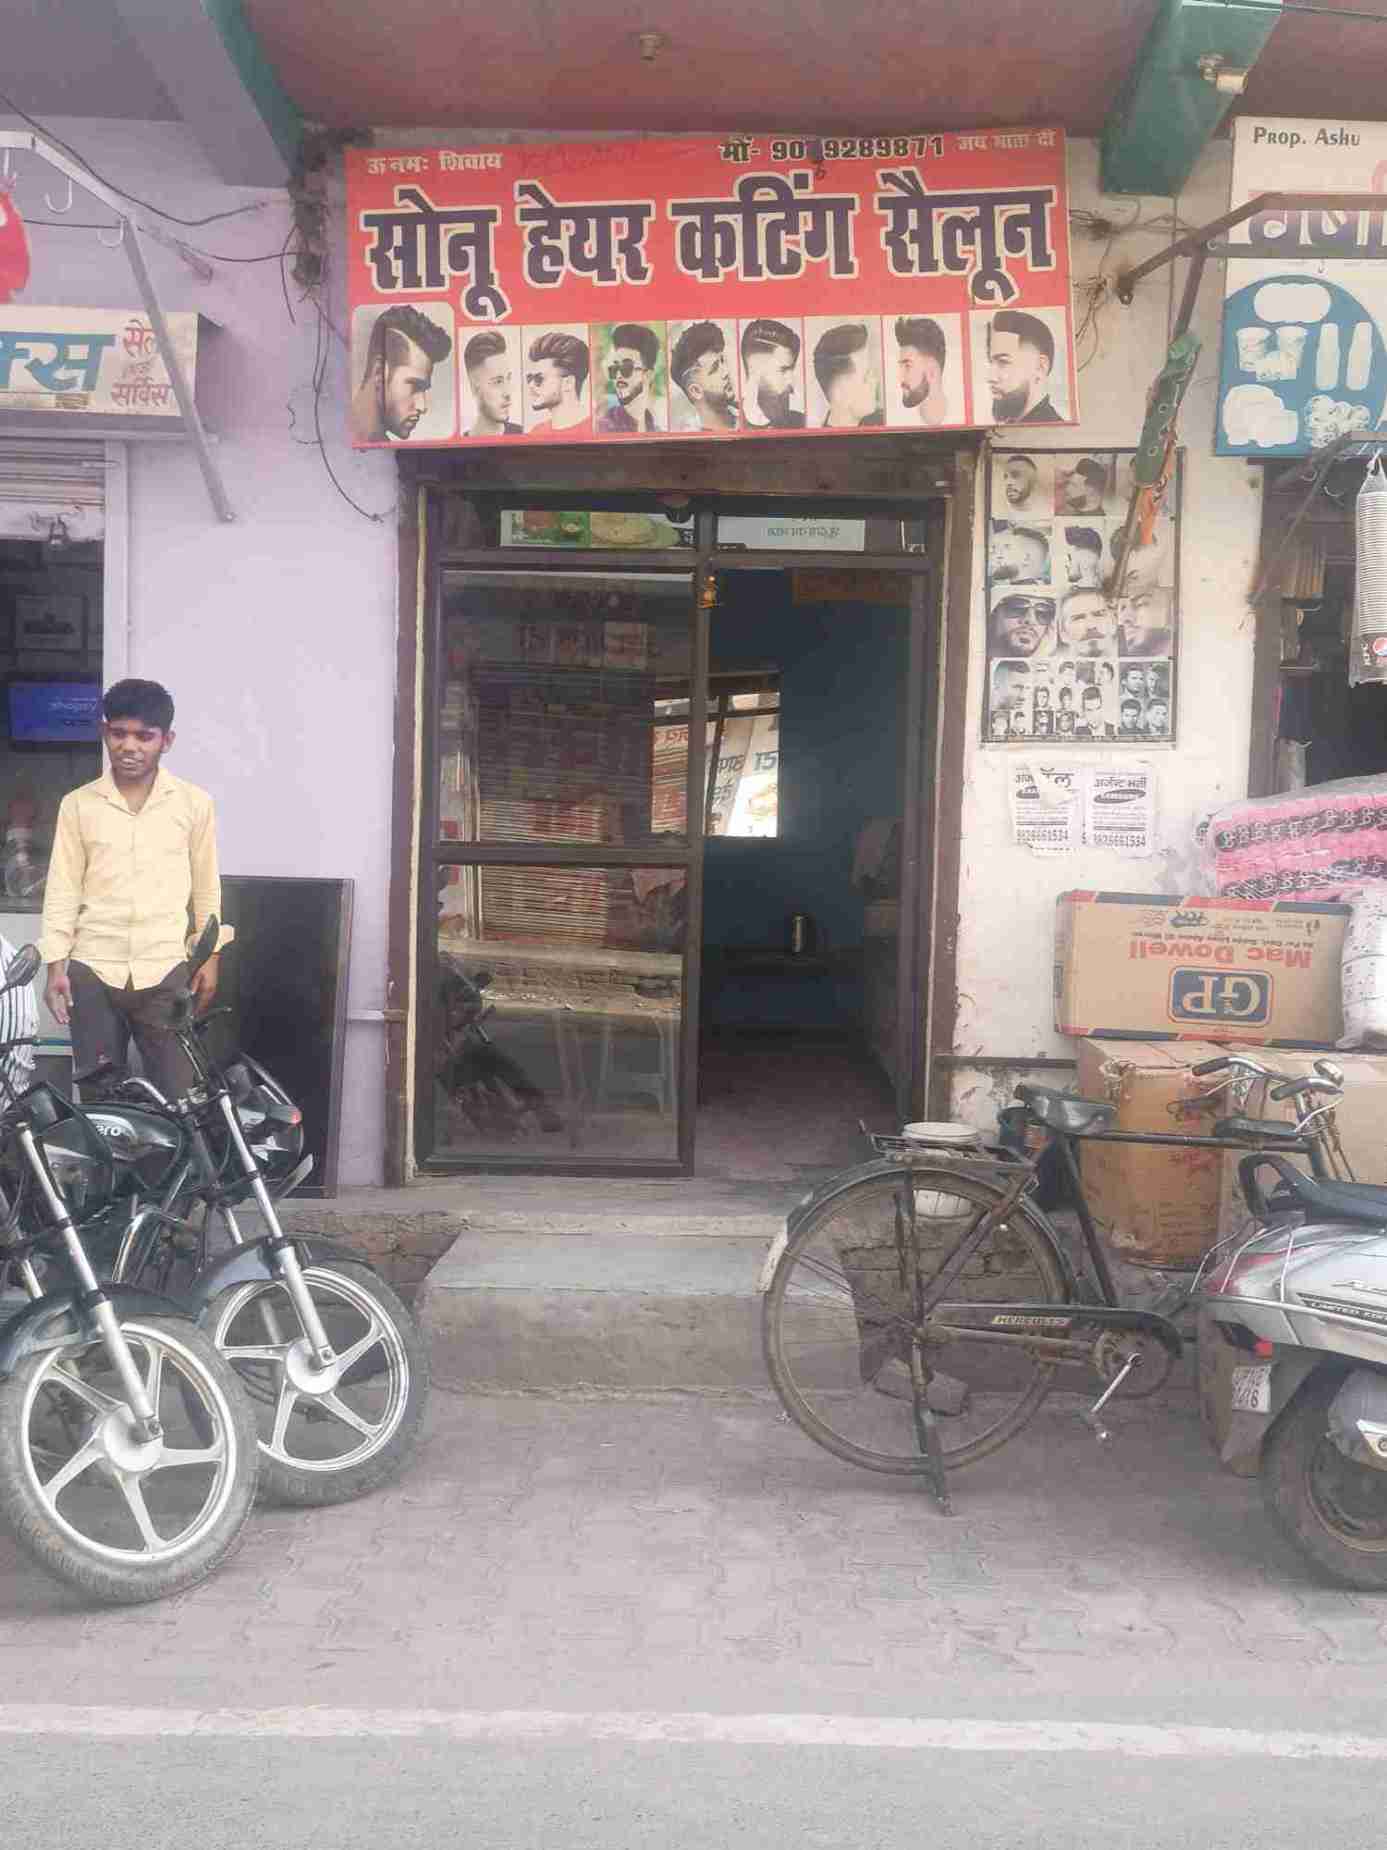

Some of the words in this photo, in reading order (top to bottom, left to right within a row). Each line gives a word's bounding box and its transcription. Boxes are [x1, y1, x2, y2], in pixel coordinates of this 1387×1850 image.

[1315, 127, 1361, 147] Ashu
[771, 136, 944, 161] 909289871
[359, 184, 511, 321] सोनू
[513, 179, 656, 289] हेयर
[667, 170, 861, 283] कटिंग
[873, 165, 1057, 305] सैलून
[1127, 942, 1235, 963] Dowell
[1247, 946, 1314, 968] Mac
[94, 1124, 122, 1138] ero
